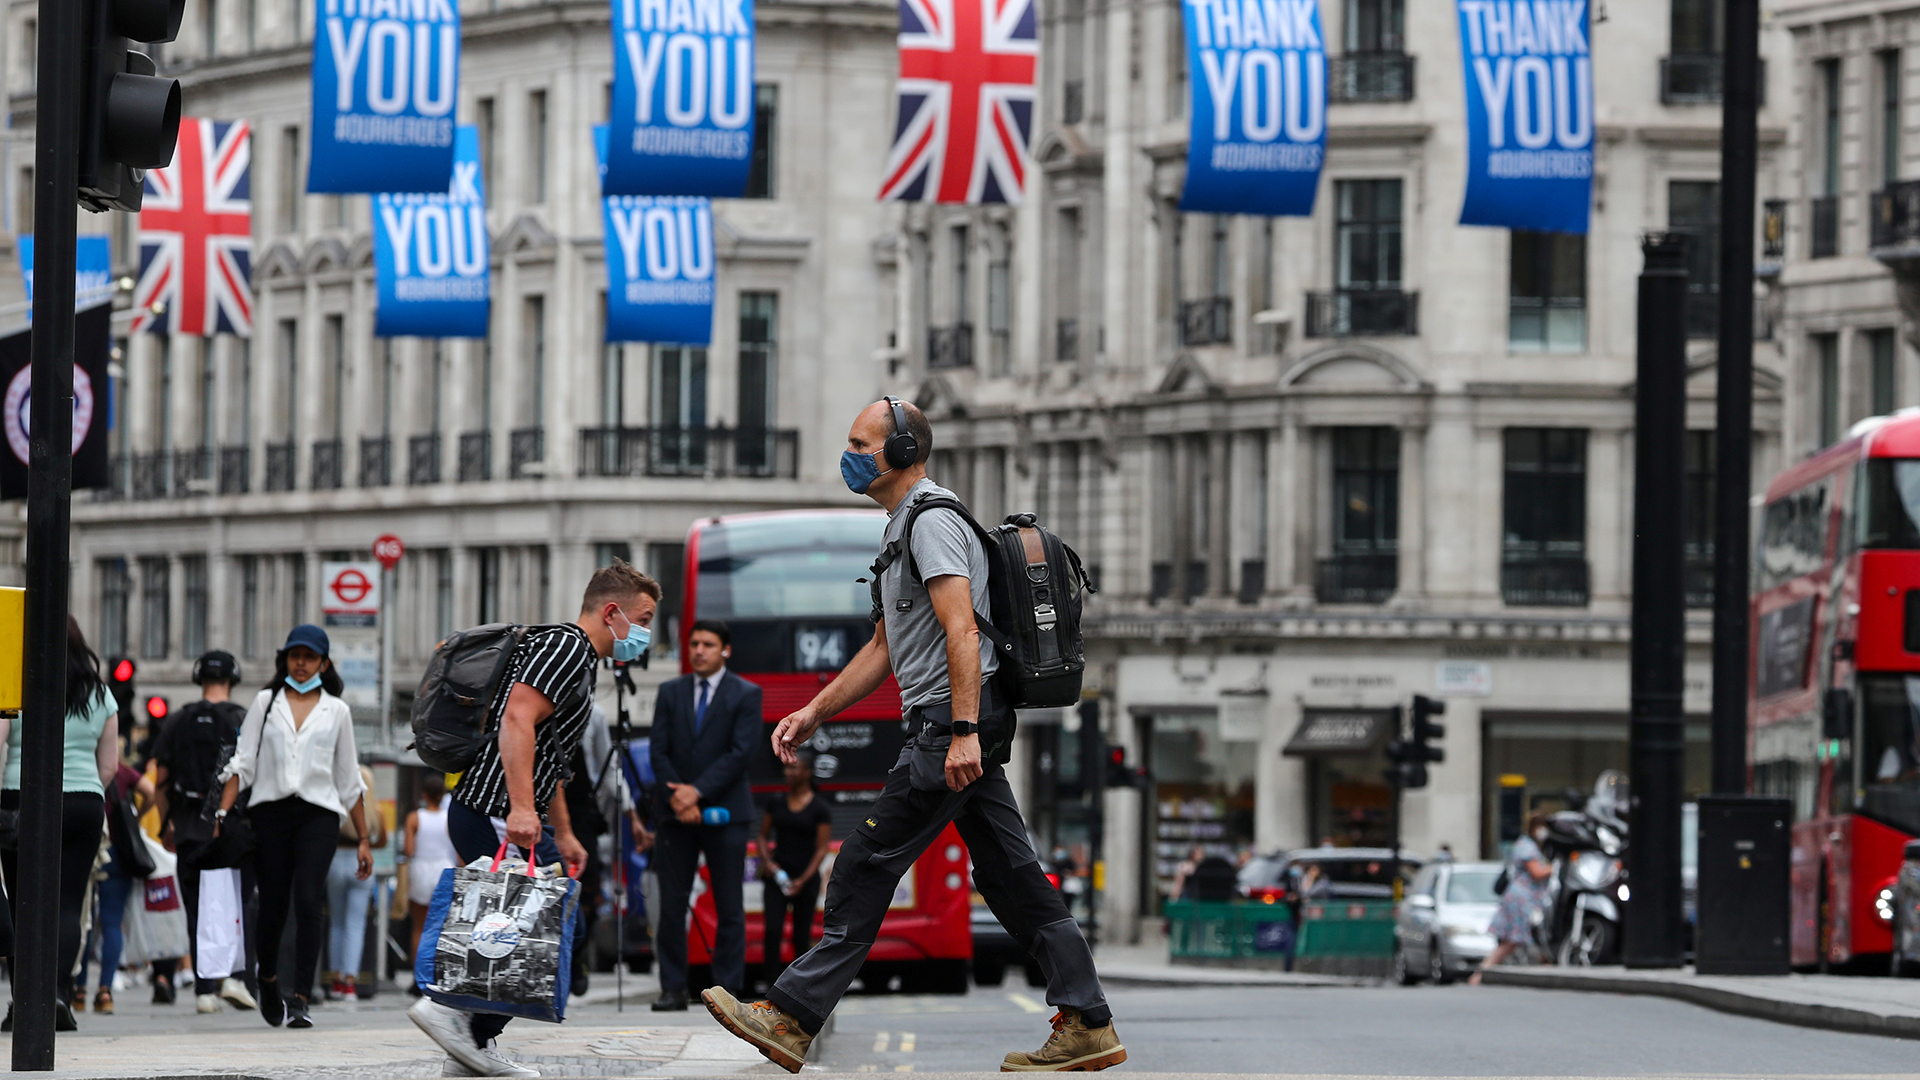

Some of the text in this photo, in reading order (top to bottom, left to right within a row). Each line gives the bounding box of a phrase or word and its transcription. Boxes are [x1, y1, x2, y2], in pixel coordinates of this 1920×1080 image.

[1186, 0, 1321, 50] THANK
[1459, 0, 1588, 56] THANK
[326, 17, 457, 117] YOU
[624, 31, 751, 129] YOU
[1200, 49, 1324, 142] YOU
[334, 113, 453, 147] #OURHEROES
[1472, 56, 1591, 149] YOU
[632, 125, 750, 160] #OURHEROES
[1211, 142, 1322, 172] #OURHEROES
[381, 204, 487, 277] YOU
[610, 207, 714, 280] YOU
[800, 632, 842, 668] 94
